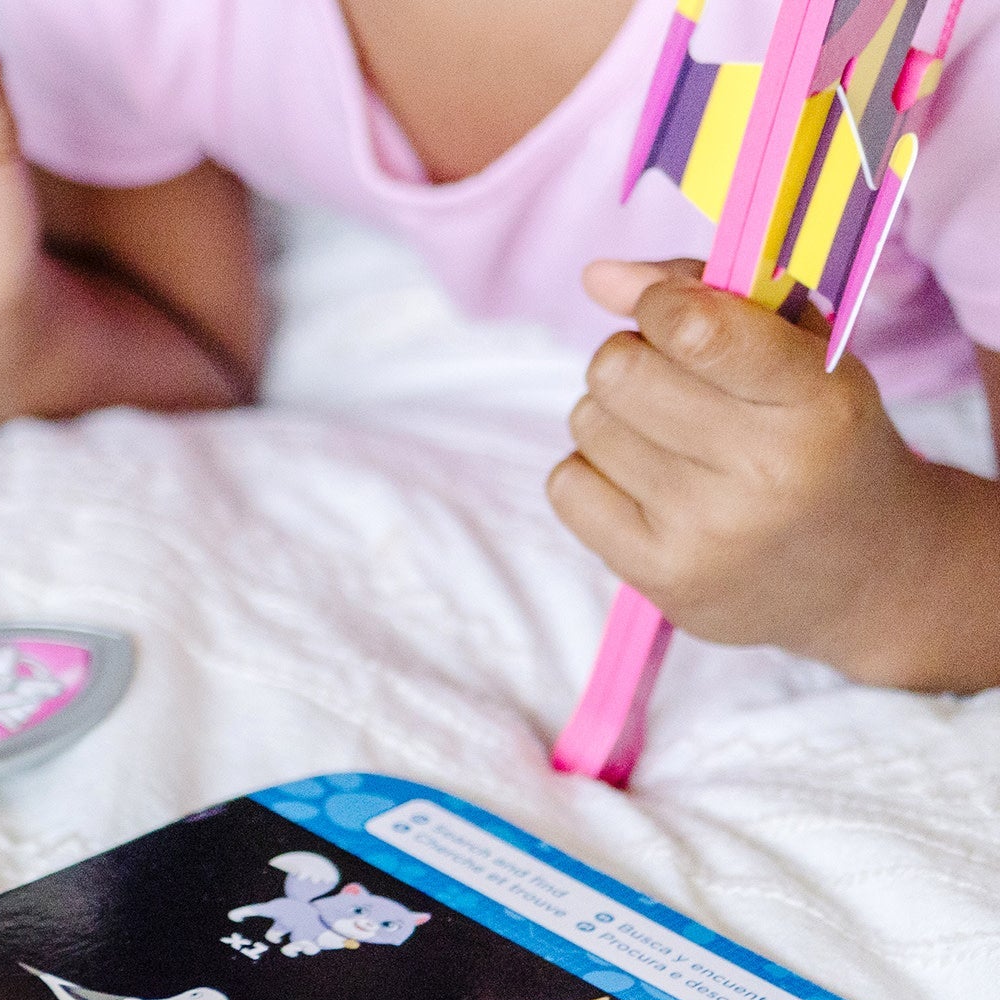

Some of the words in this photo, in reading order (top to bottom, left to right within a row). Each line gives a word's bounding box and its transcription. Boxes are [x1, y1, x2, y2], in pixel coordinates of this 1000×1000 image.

[413, 832, 484, 873] Cherche
[487, 871, 507, 885] et
[509, 884, 567, 917] trouve
[434, 825, 491, 858] Search
[494, 857, 529, 877] and
[530, 876, 570, 898] find
[219, 932, 269, 960] x1
[599, 932, 667, 972] Procura
[669, 970, 683, 979] e
[618, 923, 673, 955] Busca
[673, 953, 691, 963] y
